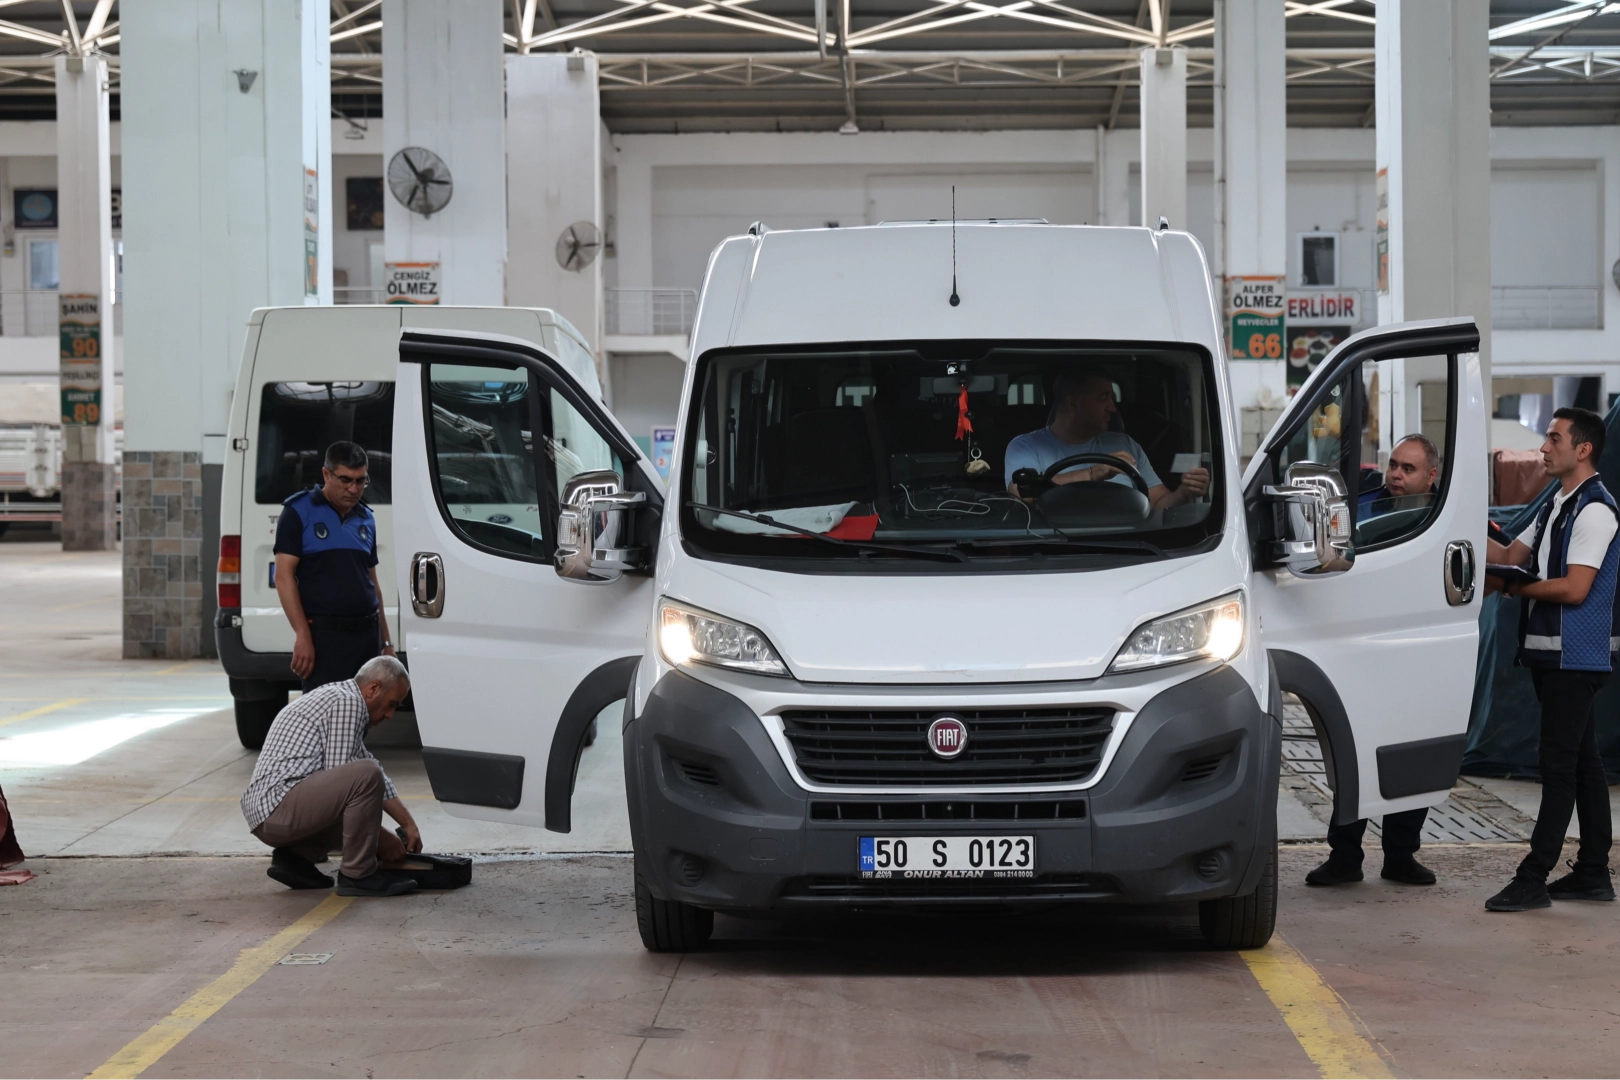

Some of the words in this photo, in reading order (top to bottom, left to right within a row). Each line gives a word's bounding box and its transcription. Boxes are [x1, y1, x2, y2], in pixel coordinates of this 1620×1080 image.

[393, 270, 431, 281] CENGİZ
[387, 280, 438, 295] ÖLMEZ
[1243, 285, 1274, 294] ALPER
[1233, 294, 1283, 308] ÖLMEZ
[62, 302, 98, 317] ŞAHİN
[72, 338, 98, 357] 90
[1248, 333, 1282, 359] 66
[74, 403, 99, 423] 89
[937, 728, 959, 747] FIAT
[862, 855, 873, 864] TR
[876, 839, 908, 868] 50
[932, 839, 947, 868] S
[969, 839, 1030, 868] 0123
[903, 870, 942, 878] ONUR
[943, 870, 984, 878] ALTAN
